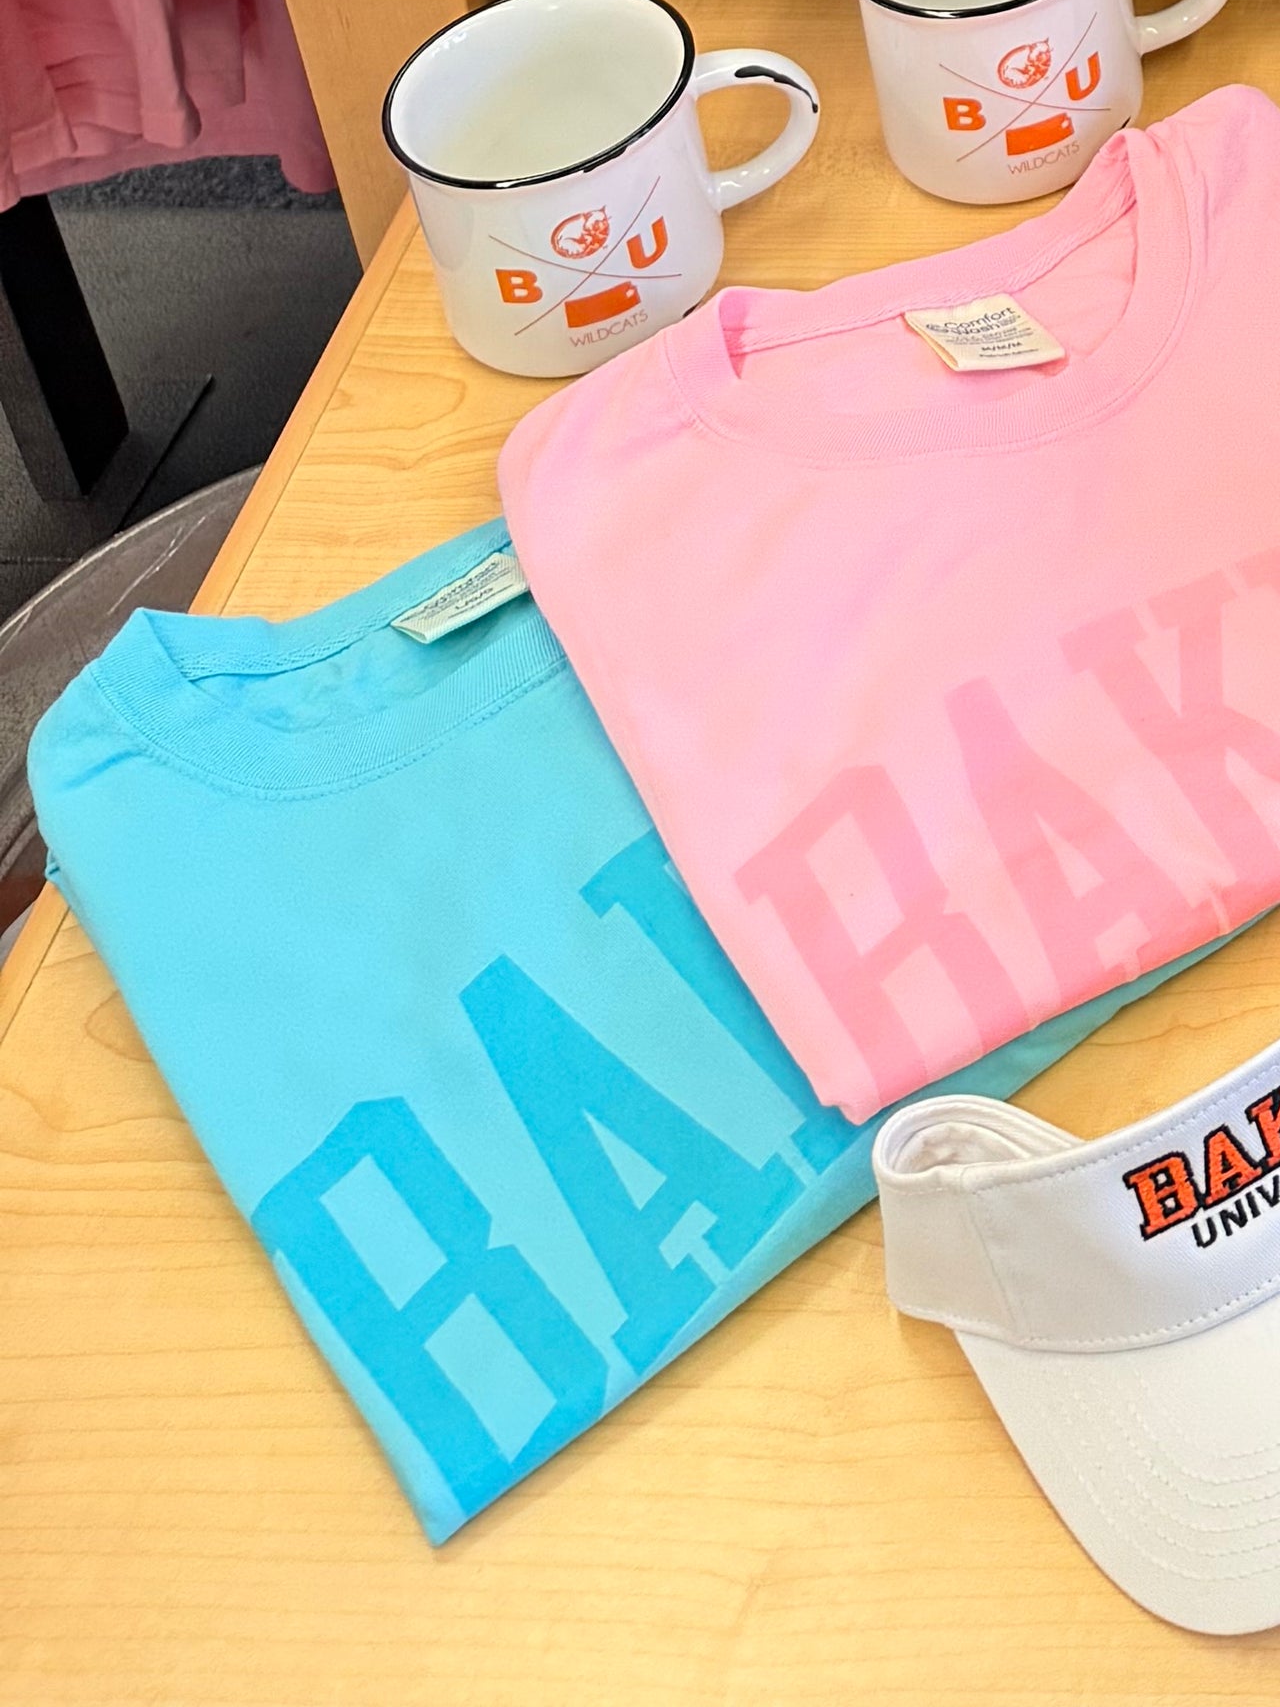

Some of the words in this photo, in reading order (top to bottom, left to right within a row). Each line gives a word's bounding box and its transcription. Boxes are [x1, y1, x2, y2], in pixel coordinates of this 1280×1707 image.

[1065, 50, 1102, 102] U
[942, 97, 987, 131] B
[1007, 141, 1081, 176] WILDCATS
[626, 215, 669, 270] U
[494, 268, 544, 305] B
[569, 309, 649, 348] WILDCATS
[943, 306, 1016, 329] Comfort
[949, 324, 1000, 337] Wash
